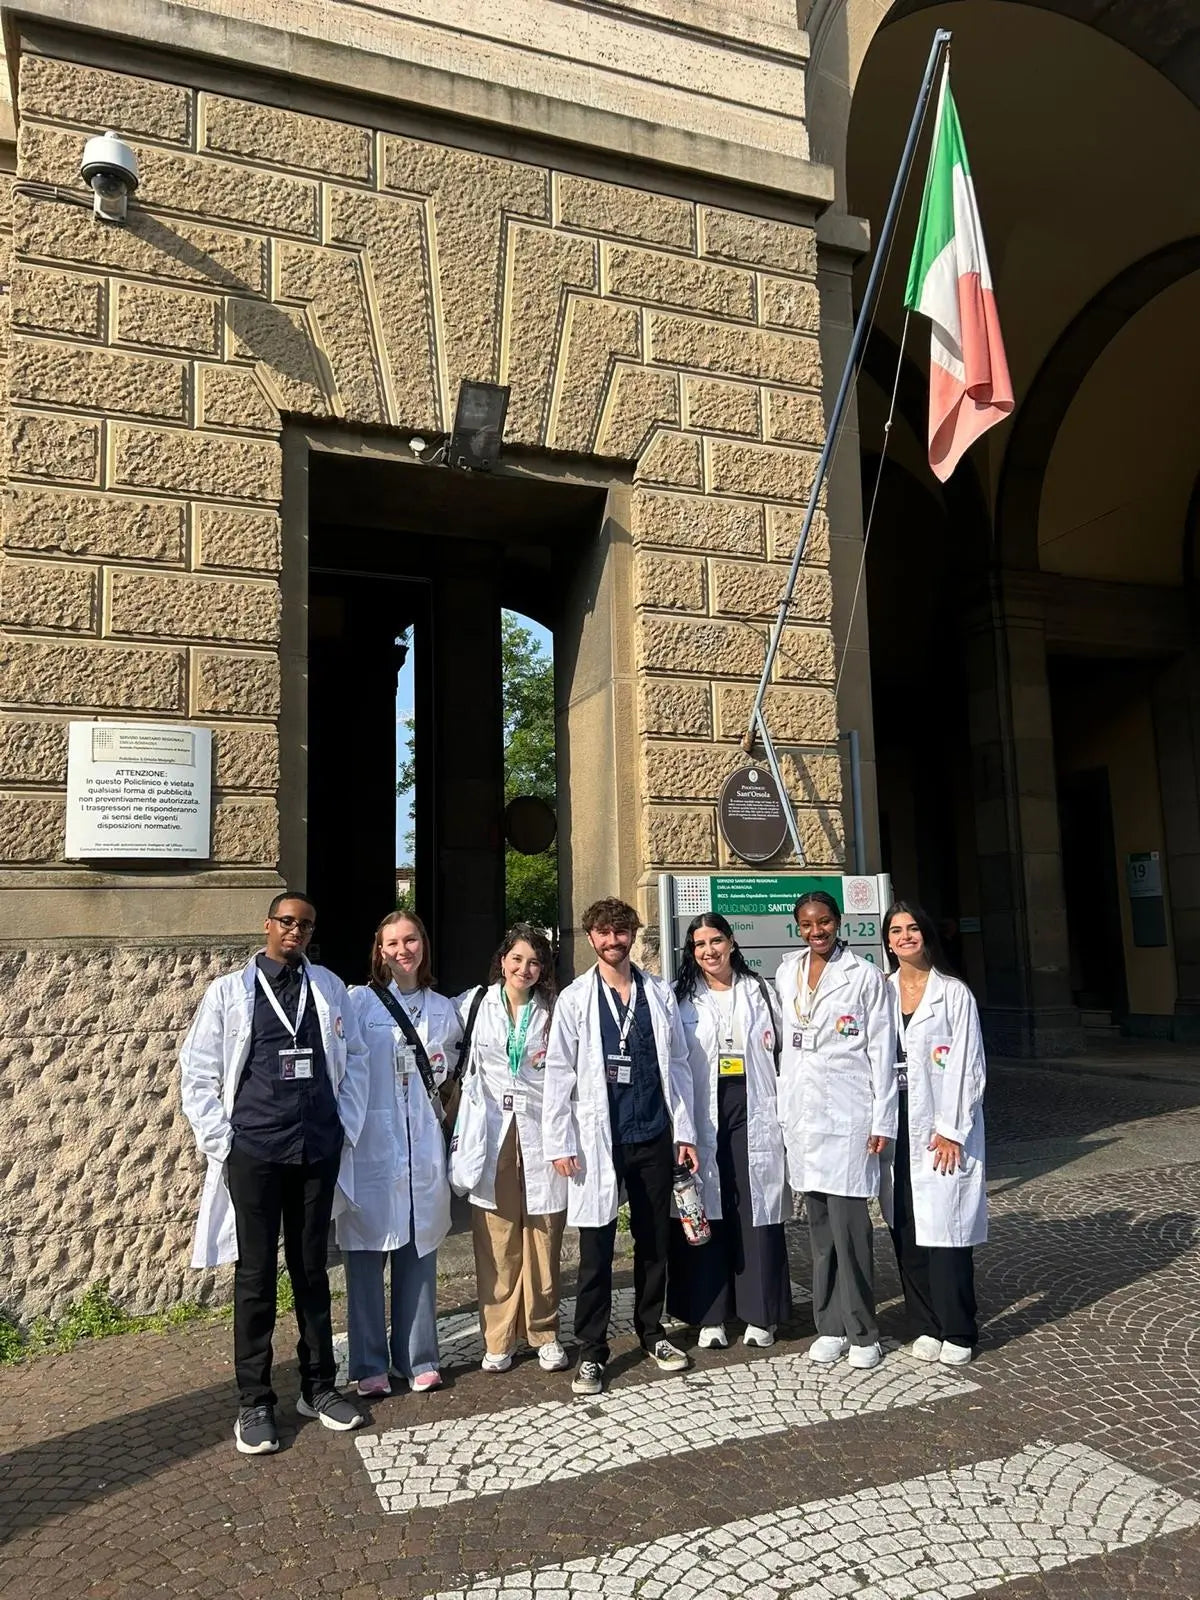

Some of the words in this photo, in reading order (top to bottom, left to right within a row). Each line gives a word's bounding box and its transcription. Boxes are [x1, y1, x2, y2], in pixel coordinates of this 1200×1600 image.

[115, 769, 168, 777] ATTENZIONE:
[145, 805, 198, 813] risponderanno
[1132, 864, 1146, 879] 19
[718, 904, 757, 912] POLICLINICO
[760, 904, 766, 912] DI
[730, 921, 754, 931] glioni
[745, 959, 762, 967] one
